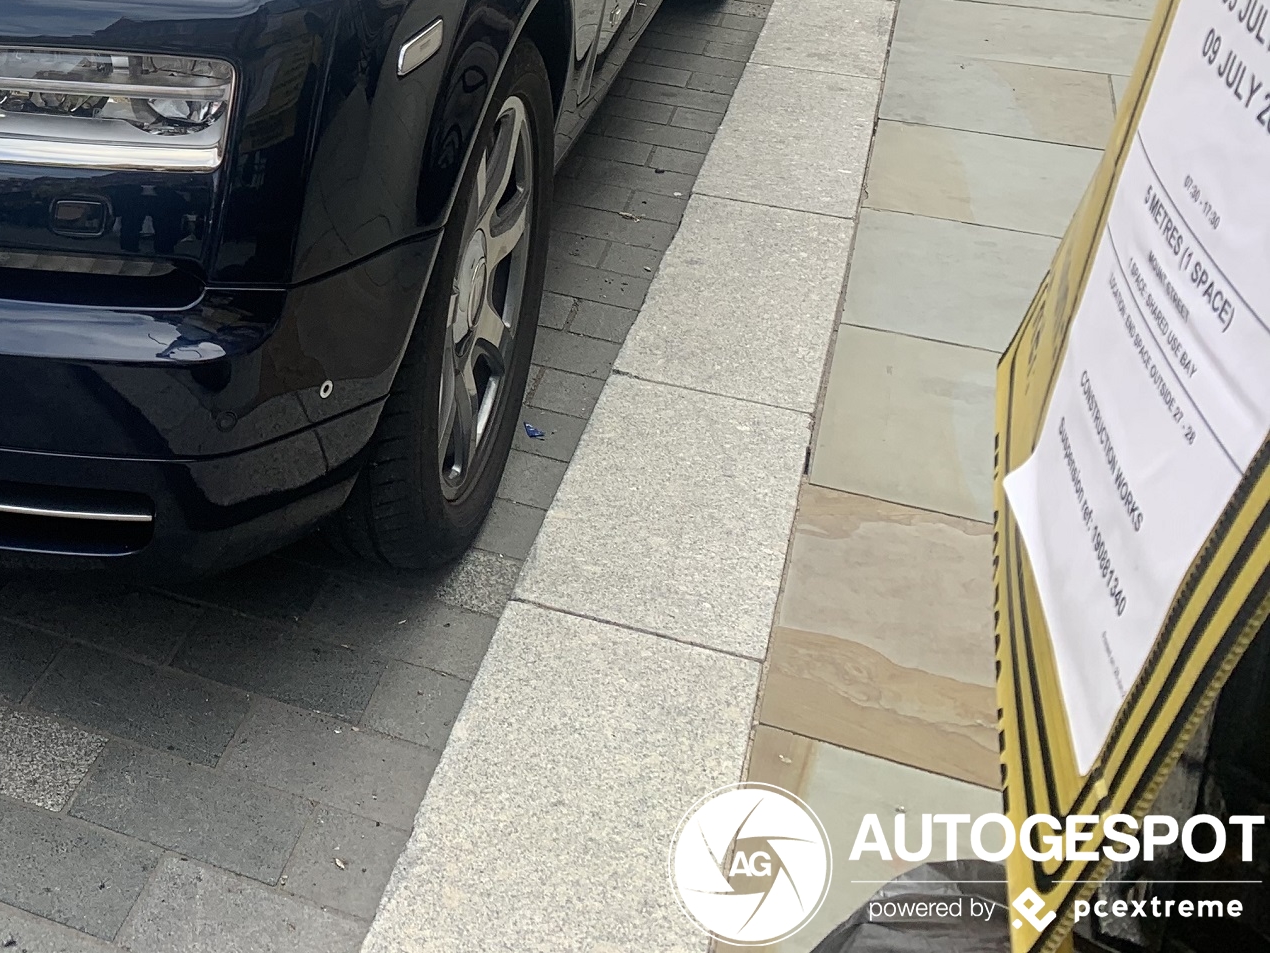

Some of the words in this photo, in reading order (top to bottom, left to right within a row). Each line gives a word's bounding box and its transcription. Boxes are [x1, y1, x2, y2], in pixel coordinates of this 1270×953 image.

[1202, 28, 1222, 65] 09
[1218, 51, 1263, 108] JULY
[1256, 91, 1270, 134] 2
[1183, 174, 1201, 202] 07:30
[1202, 201, 1221, 230] 17:30
[1144, 184, 1152, 205] 5
[1148, 197, 1183, 256] METRES
[1179, 246, 1194, 271] (1
[1191, 261, 1235, 333] SPACE)
[1148, 249, 1168, 286] MOUNT
[1165, 282, 1190, 323] STREET
[1125, 314, 1137, 338] END
[1133, 333, 1152, 370] SPACE
[1149, 364, 1176, 412] OUTSIDE
[1173, 406, 1185, 425] 27
[1184, 426, 1197, 446] 28
[1145, 293, 1169, 336] SHARED
[1167, 333, 1181, 358] USE
[1179, 349, 1198, 379] BAY
[1059, 416, 1085, 505] Suspension
[1080, 498, 1095, 532] ref:
[1081, 370, 1118, 476] CONSTRUCTION
[1114, 466, 1144, 533] WORKS
